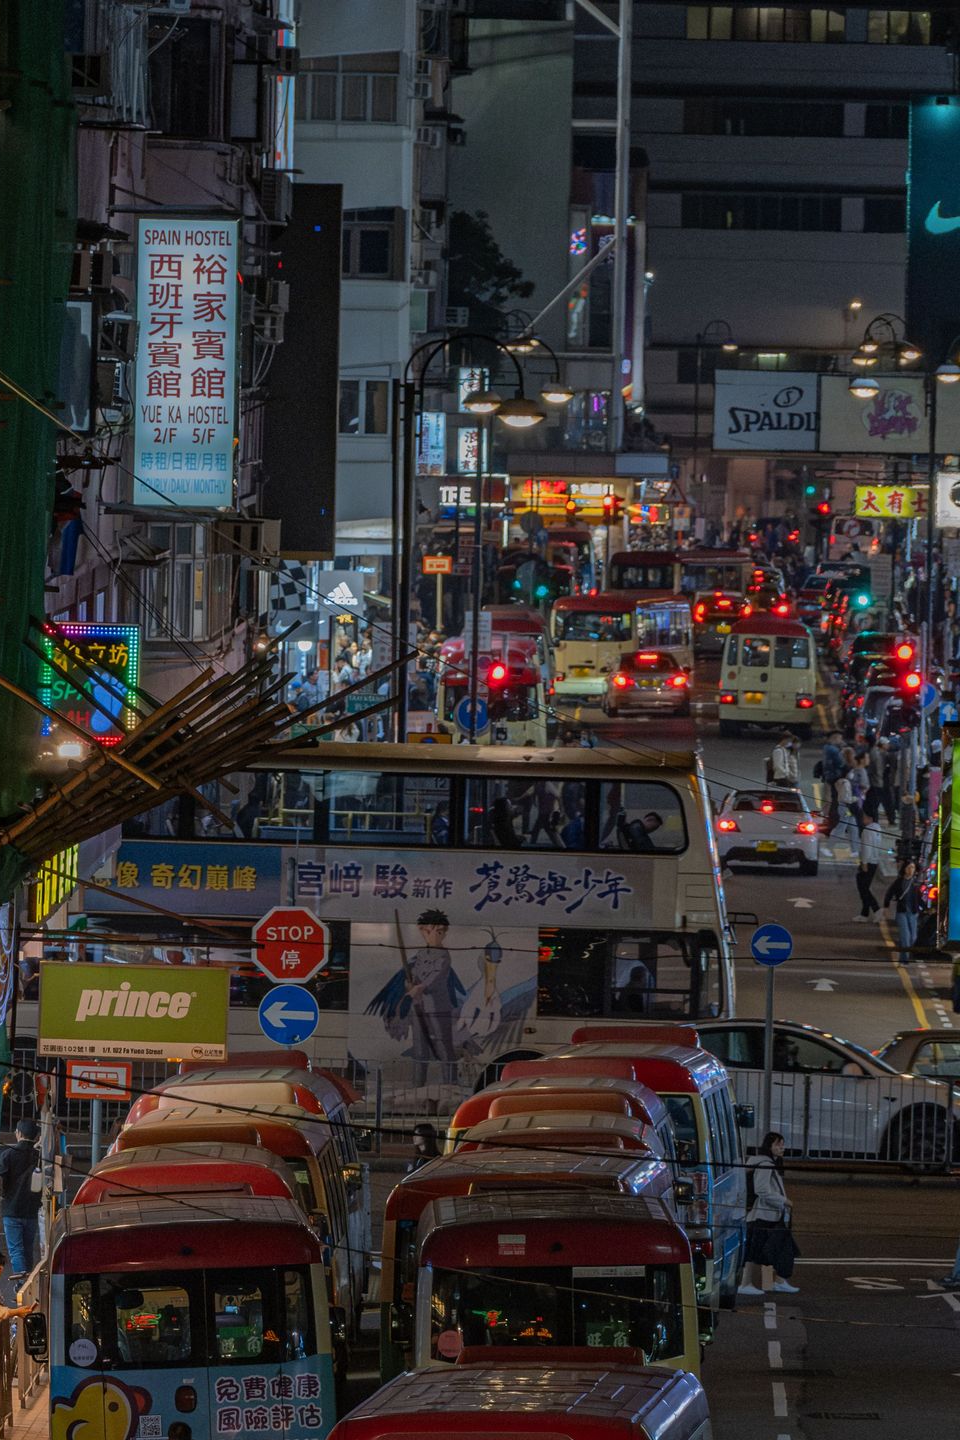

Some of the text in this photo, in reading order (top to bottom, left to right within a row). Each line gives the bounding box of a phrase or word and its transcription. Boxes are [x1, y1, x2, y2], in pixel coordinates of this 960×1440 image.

[144, 229, 232, 246] SPAIN HOSTEL
[146, 253, 184, 398] 西班牙賓館
[191, 253, 227, 399] 裕家賓館
[141, 405, 229, 424] YUE KA HOSTEL
[727, 406, 819, 434] SPALDI
[153, 427, 216, 445] 2/F 5/F
[266, 925, 314, 941] STOP
[280, 949, 301, 971] 停
[75, 981, 191, 1022] prince
[216, 1374, 321, 1402] 免費健康
[216, 1404, 323, 1432] 風險評估
